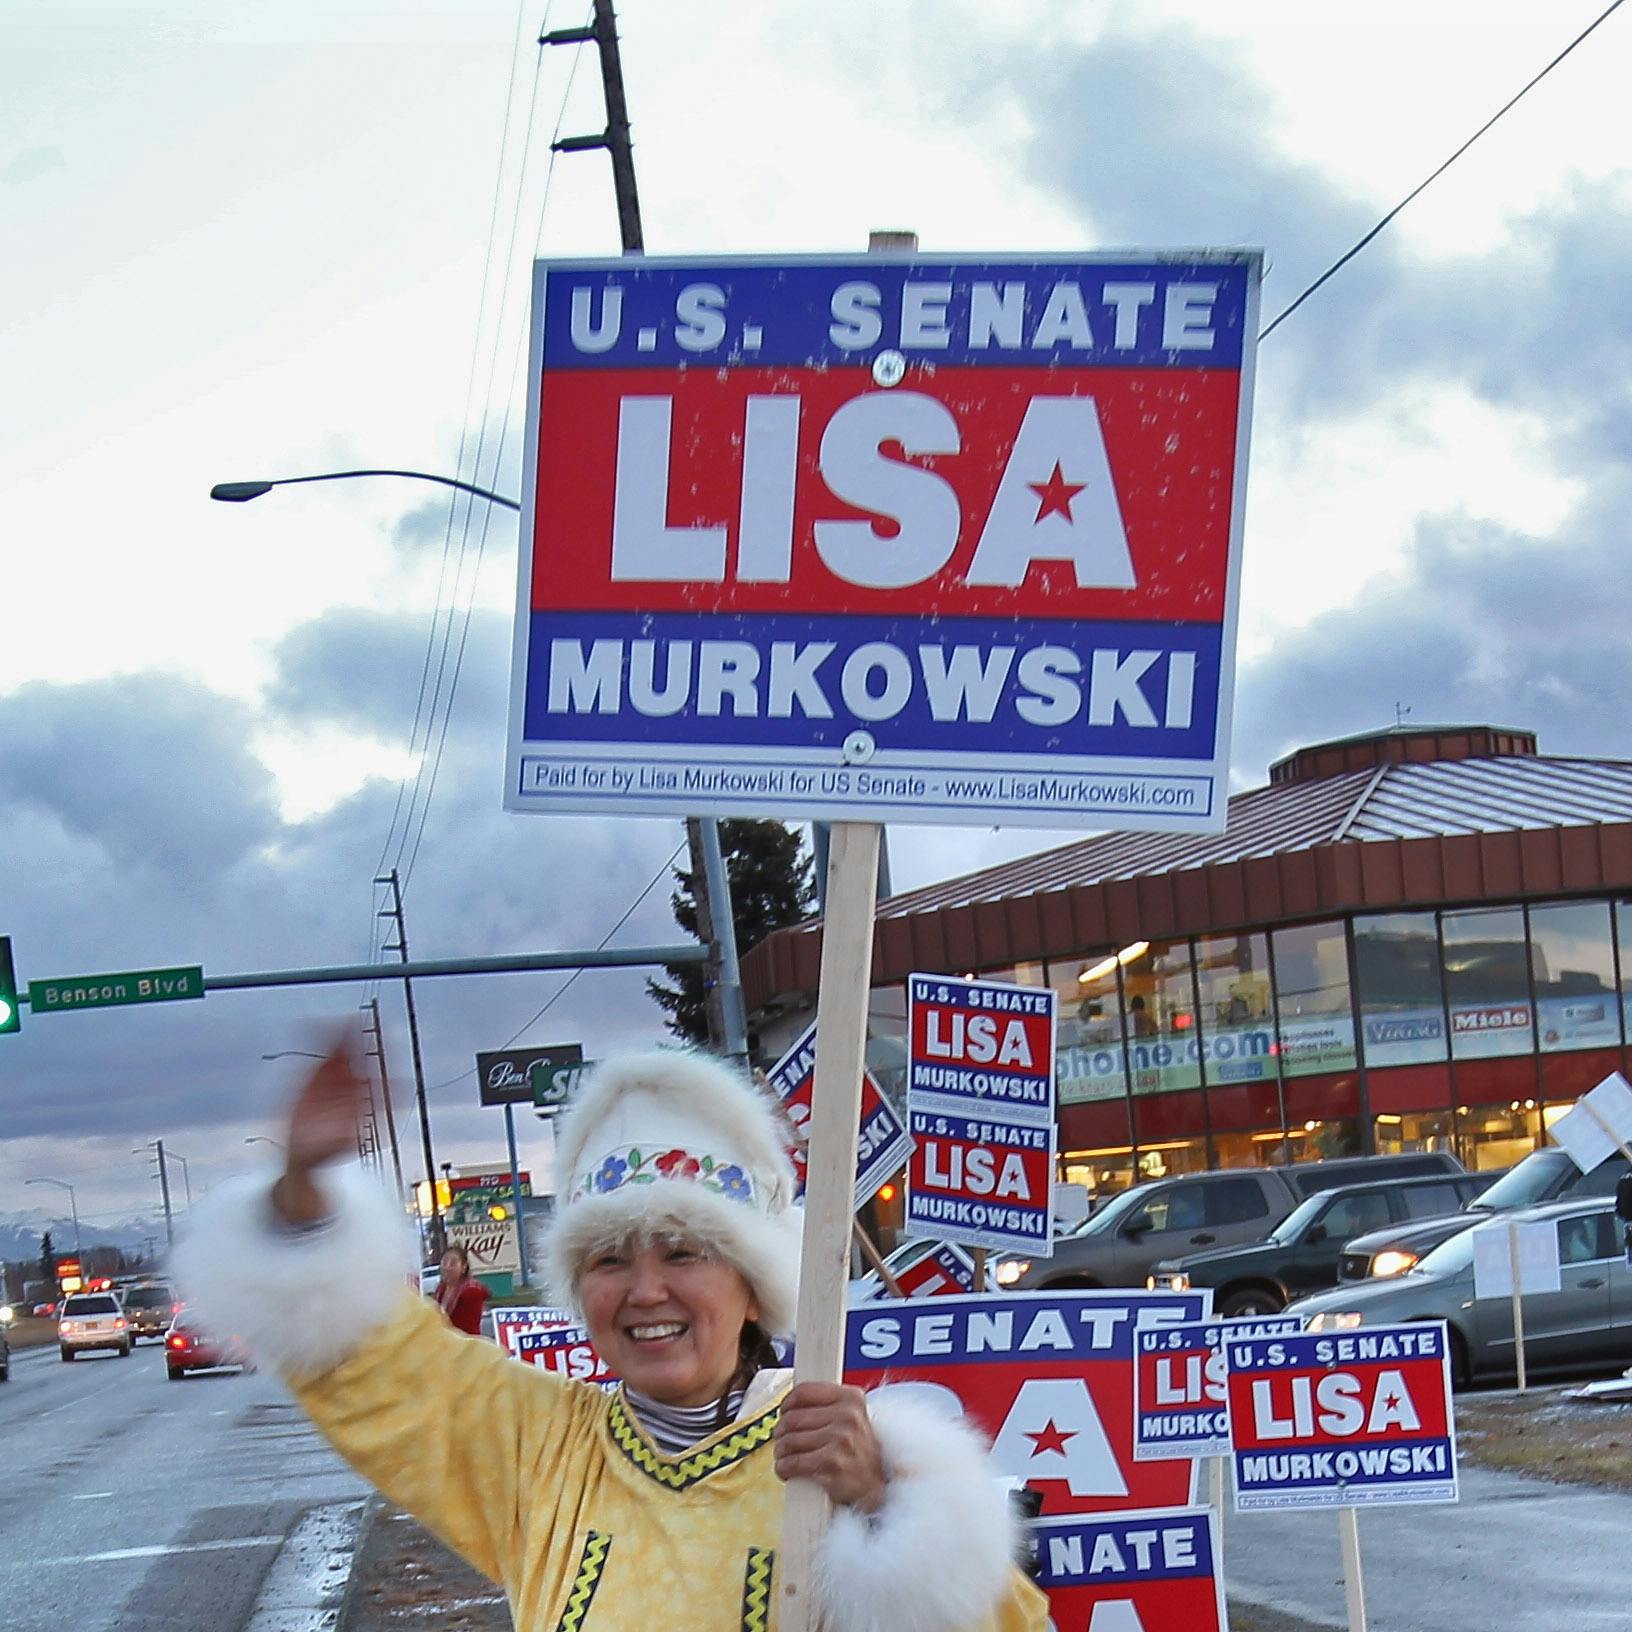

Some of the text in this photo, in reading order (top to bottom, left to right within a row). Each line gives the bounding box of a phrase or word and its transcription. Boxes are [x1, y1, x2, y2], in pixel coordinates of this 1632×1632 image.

[569, 281, 1220, 353] U.S. SENATE
[611, 390, 1137, 588] LISA
[546, 638, 1197, 729] MURKOWSKI
[535, 763, 576, 786] Paid
[582, 765, 606, 787] for
[611, 765, 633, 794] by
[639, 766, 677, 789] Lisa
[684, 768, 784, 793] Murkowski
[789, 770, 814, 793] for
[821, 771, 850, 794] US
[857, 774, 925, 797] Senate
[946, 777, 1195, 806] www.LisaMurkowski.com
[45, 976, 188, 1004] Benson Blvd
[917, 983, 1048, 1014] U.S. SENATE
[1454, 1008, 1527, 1030] Miele
[926, 1010, 1033, 1068] LISA
[914, 1066, 1047, 1101] MURKOWSKI
[914, 1114, 955, 1136] U.S.
[967, 1122, 1045, 1148] SENATE
[925, 1142, 1031, 1200] LISA
[913, 1196, 1044, 1234] MURKOWSKI
[522, 1334, 558, 1350] U.S.
[1143, 1331, 1192, 1351] U.S.
[1235, 1332, 1437, 1369] U.S. SENATE
[1156, 1355, 1227, 1405] LIS
[1252, 1370, 1421, 1440] LISA
[1143, 1412, 1230, 1438] MURKO
[1242, 1445, 1446, 1483] MURKOWSKI
